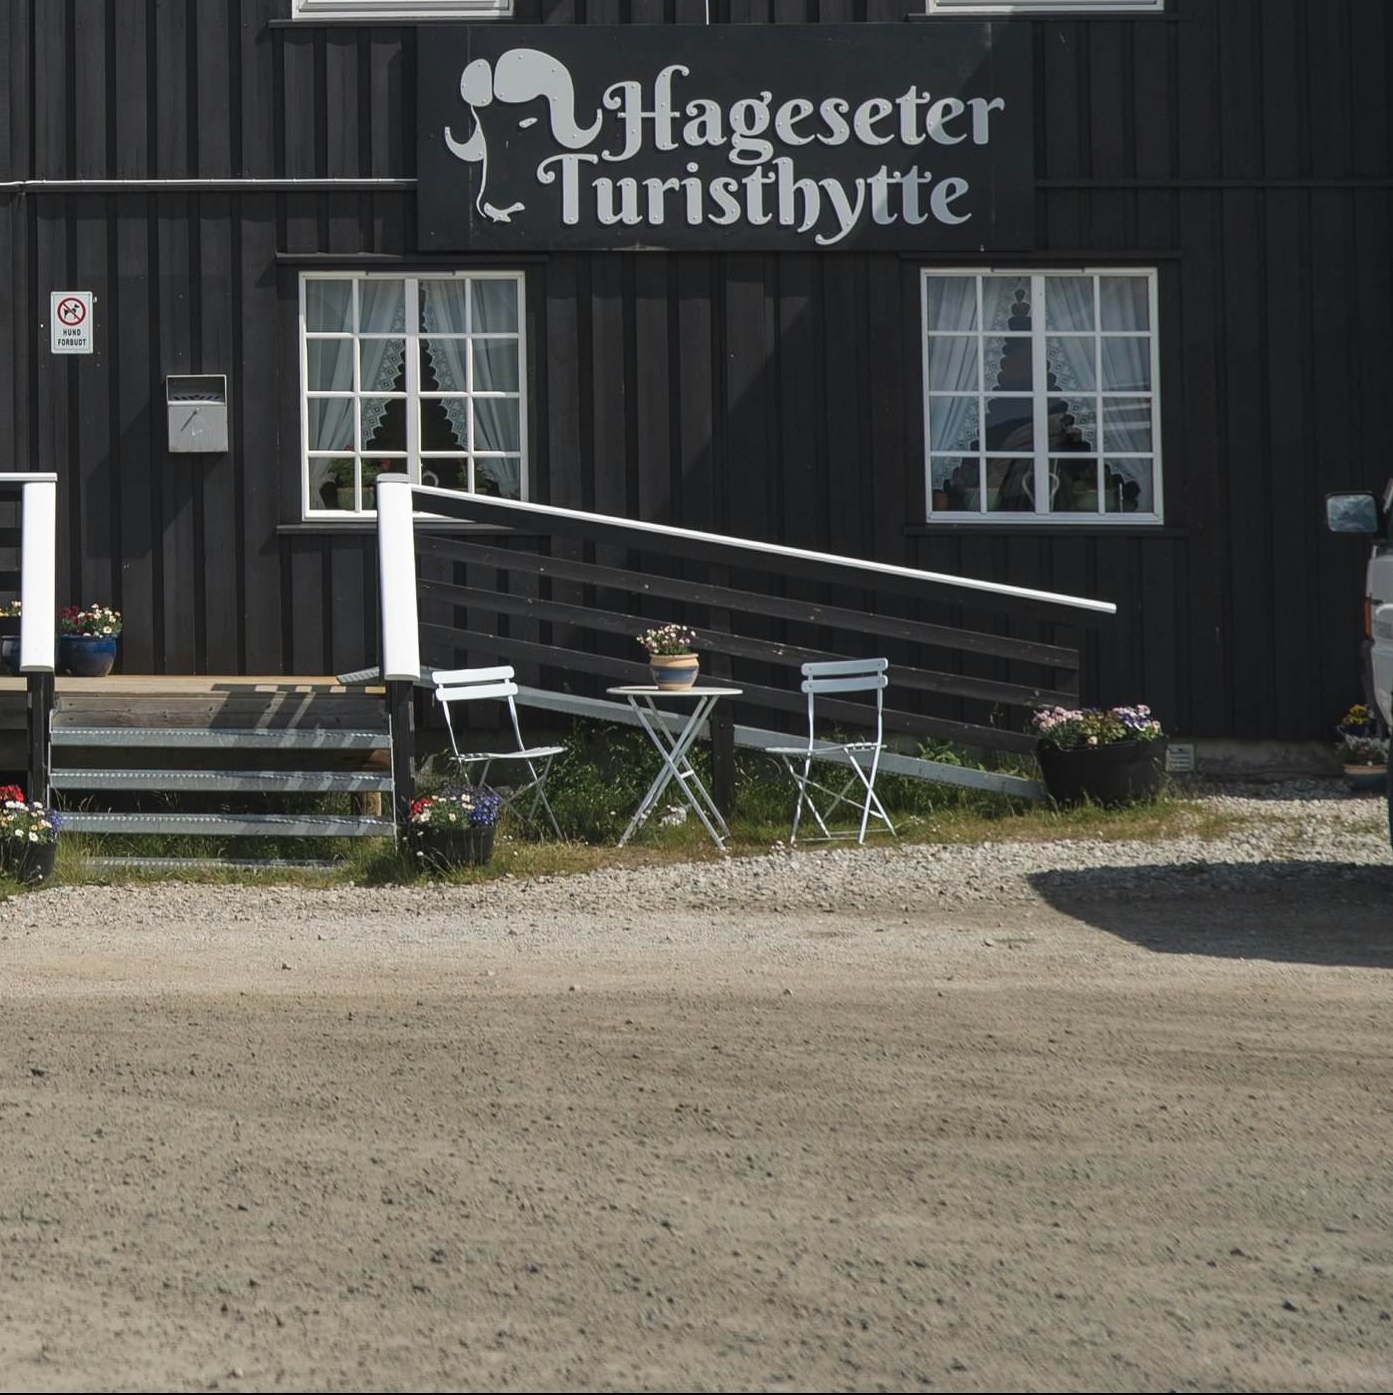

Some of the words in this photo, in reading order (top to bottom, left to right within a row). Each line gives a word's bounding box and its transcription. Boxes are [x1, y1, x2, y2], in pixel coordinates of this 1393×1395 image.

[601, 65, 1005, 165] Hageseter
[537, 153, 973, 245] Turisthytte
[57, 338, 87, 347] FORBUDT
[63, 328, 81, 336] HUND
